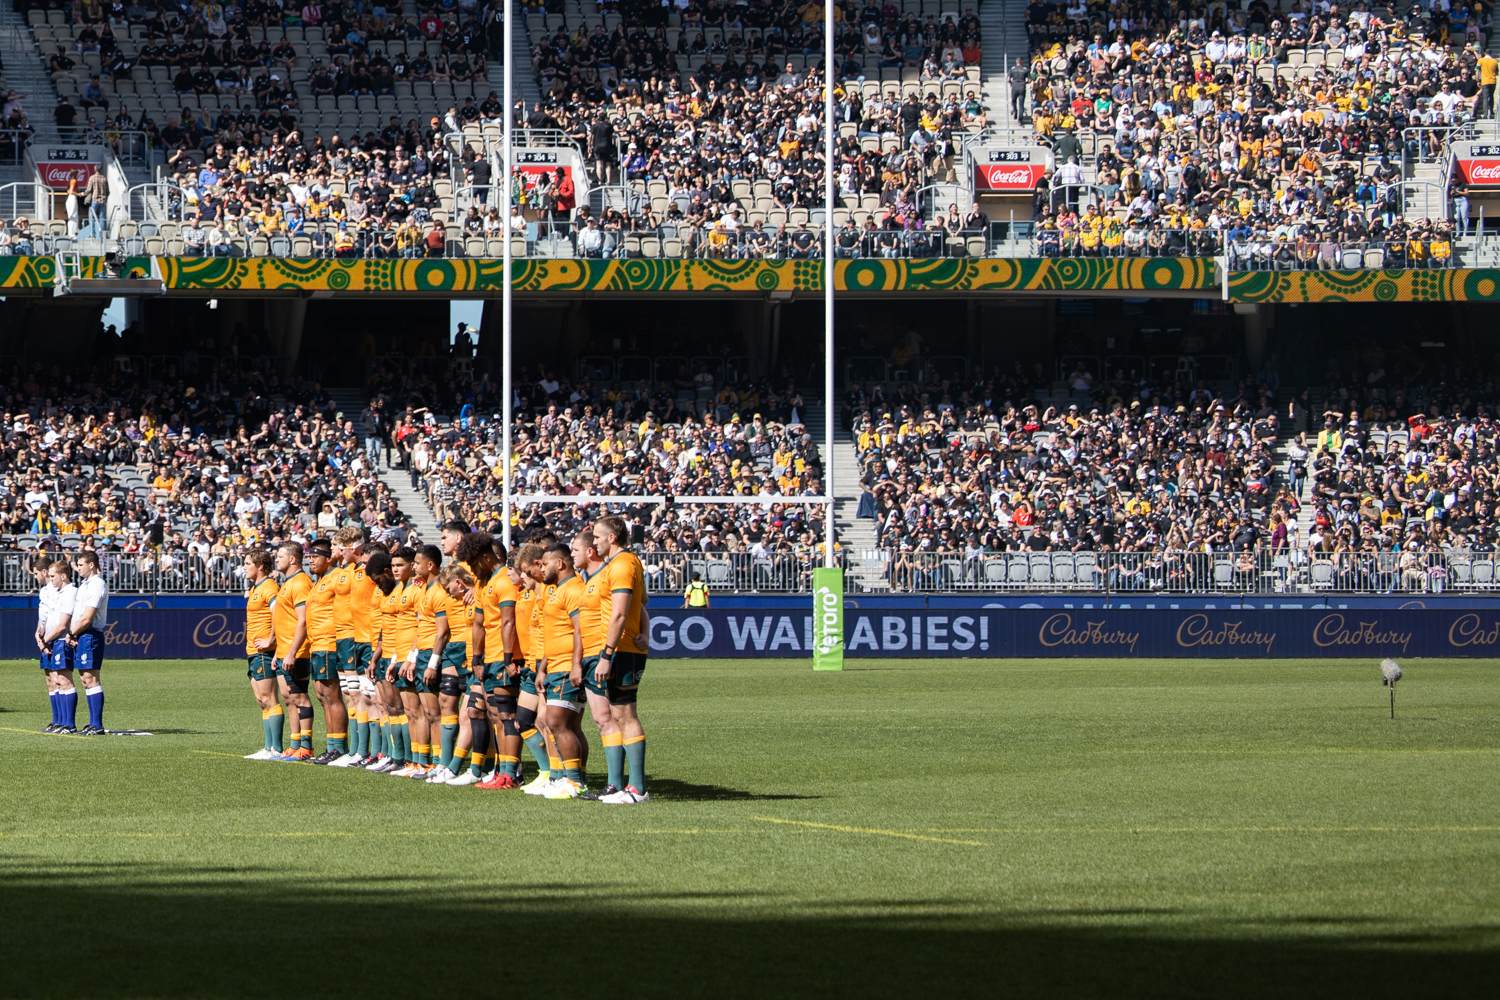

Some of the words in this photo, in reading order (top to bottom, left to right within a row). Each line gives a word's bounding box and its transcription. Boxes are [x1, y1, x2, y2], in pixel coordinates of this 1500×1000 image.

[990, 169, 1031, 184] Coca-Cola
[649, 615, 714, 651] GO
[1039, 613, 1140, 654] Cadbury
[1177, 613, 1276, 654] Cadbury
[1313, 613, 1413, 654] Cadbury
